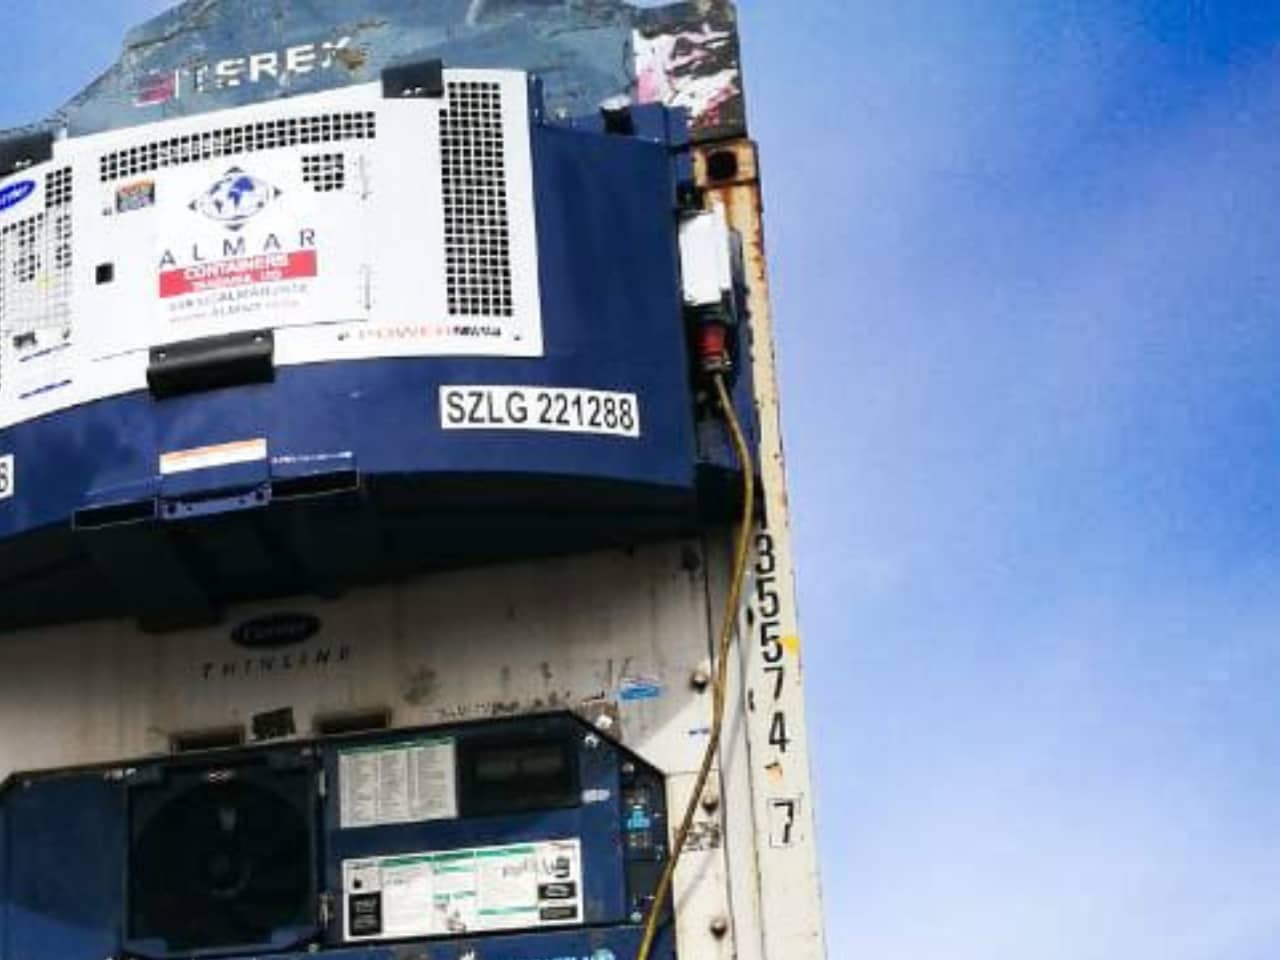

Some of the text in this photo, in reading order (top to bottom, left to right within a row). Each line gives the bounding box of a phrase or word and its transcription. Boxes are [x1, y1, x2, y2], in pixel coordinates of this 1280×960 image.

[159, 228, 316, 269] ALMAR
[446, 390, 635, 431] SZLG 221288
[773, 801, 794, 844] 7
